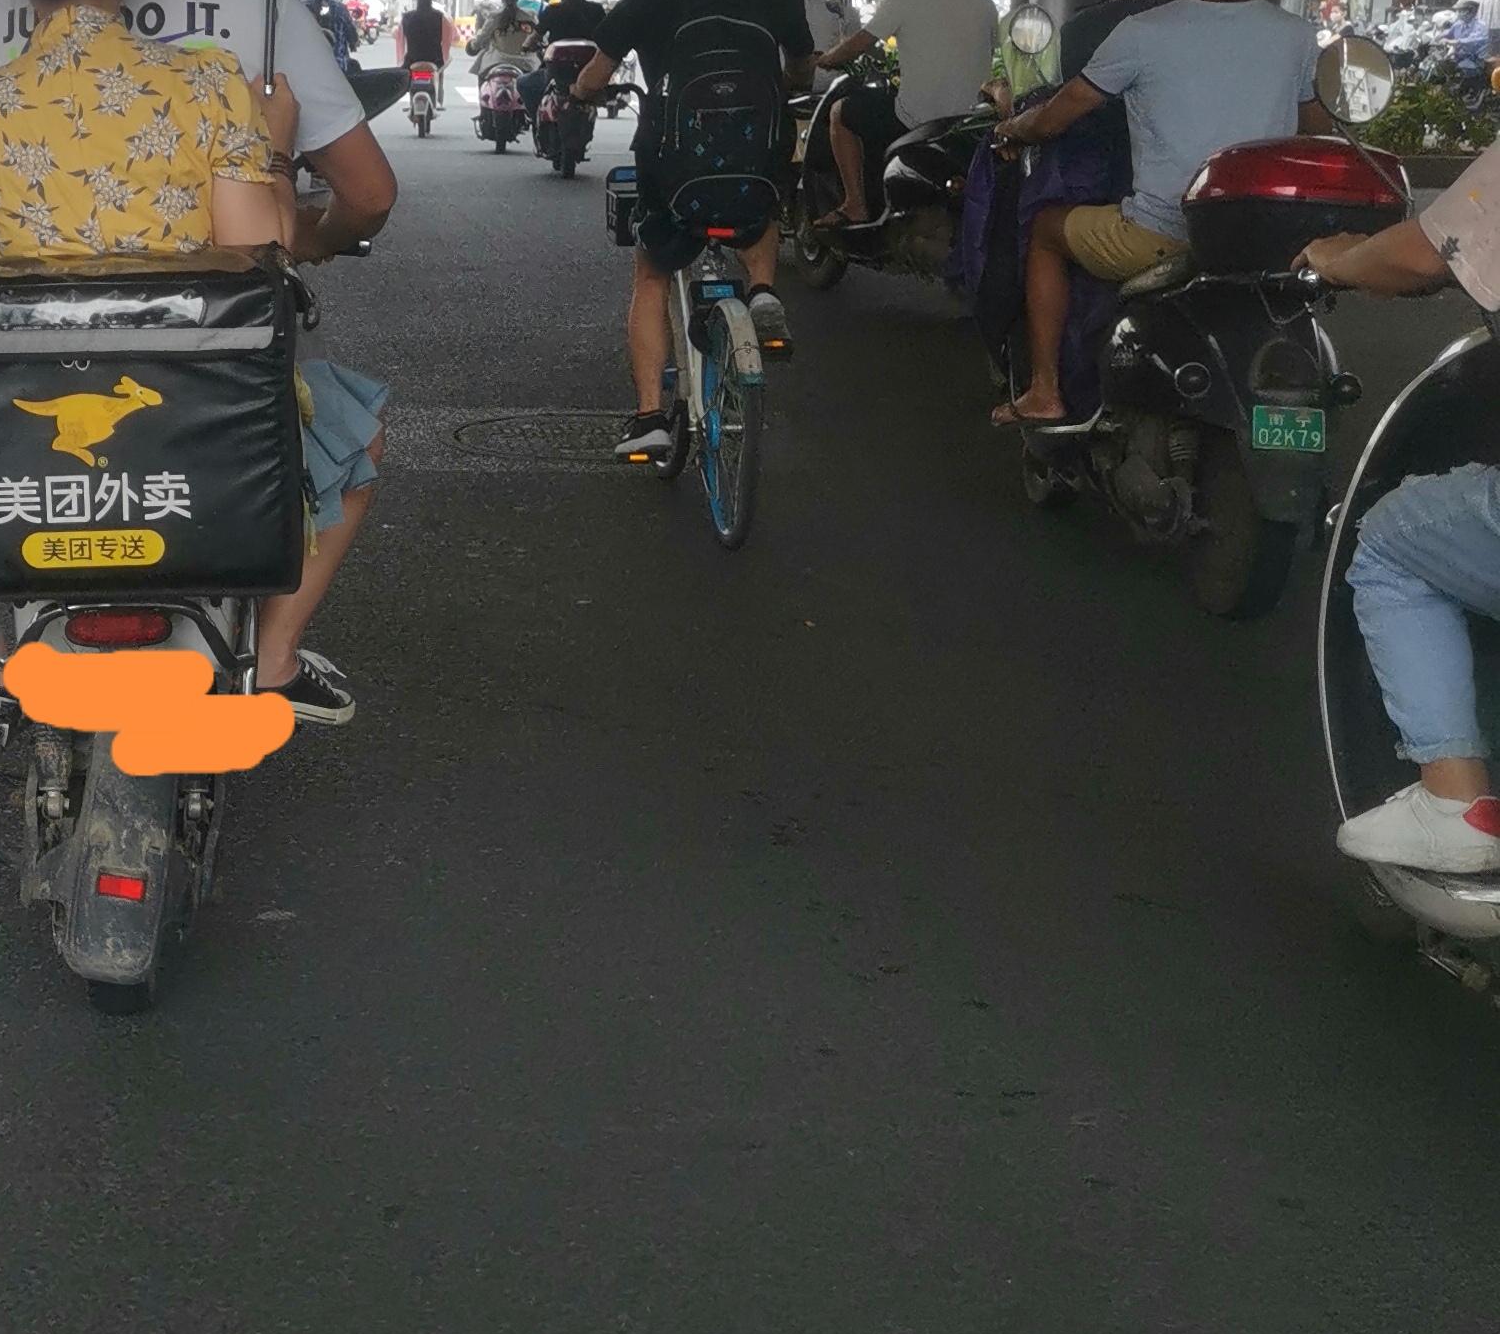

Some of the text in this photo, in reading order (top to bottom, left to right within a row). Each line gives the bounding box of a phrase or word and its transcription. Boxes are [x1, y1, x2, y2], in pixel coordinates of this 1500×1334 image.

[1258, 428, 1321, 447] 02K79
[42, 535, 145, 562] 美团专送
